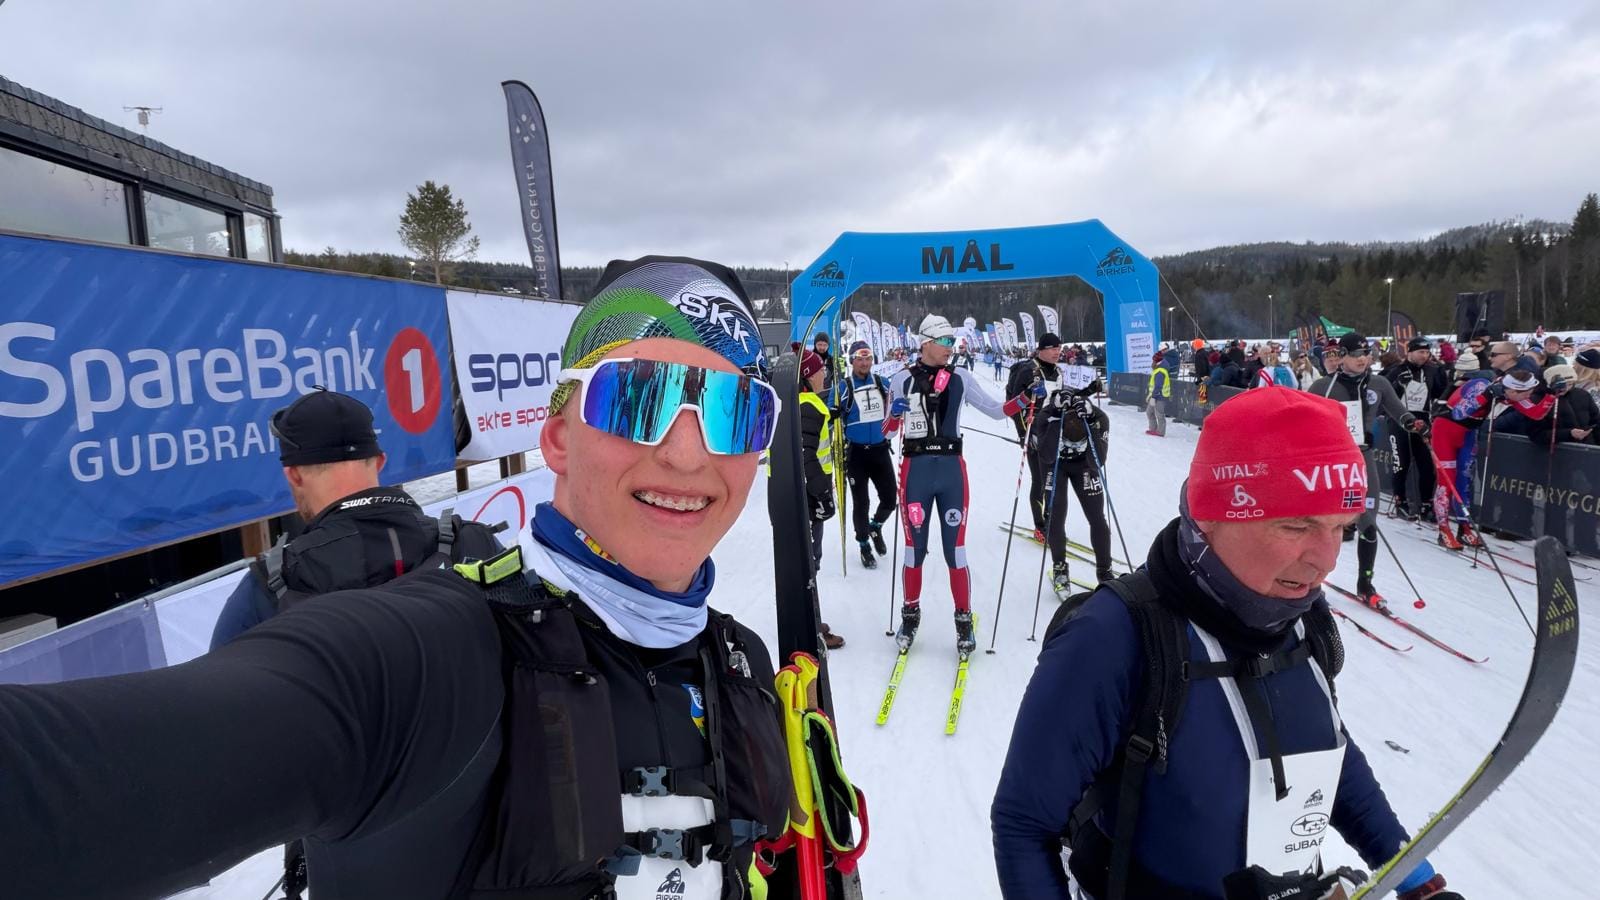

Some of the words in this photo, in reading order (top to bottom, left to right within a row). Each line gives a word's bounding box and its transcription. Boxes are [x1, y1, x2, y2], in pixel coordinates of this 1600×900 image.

[922, 239, 1014, 274] MÅL
[1096, 266, 1135, 277] BIRKEN
[811, 280, 844, 289] BIRKEN
[0, 321, 376, 432] SpareBank
[402, 348, 425, 414] 1
[910, 421, 927, 431] 361
[1212, 463, 1254, 480] VITAL
[340, 497, 373, 510] SWIX
